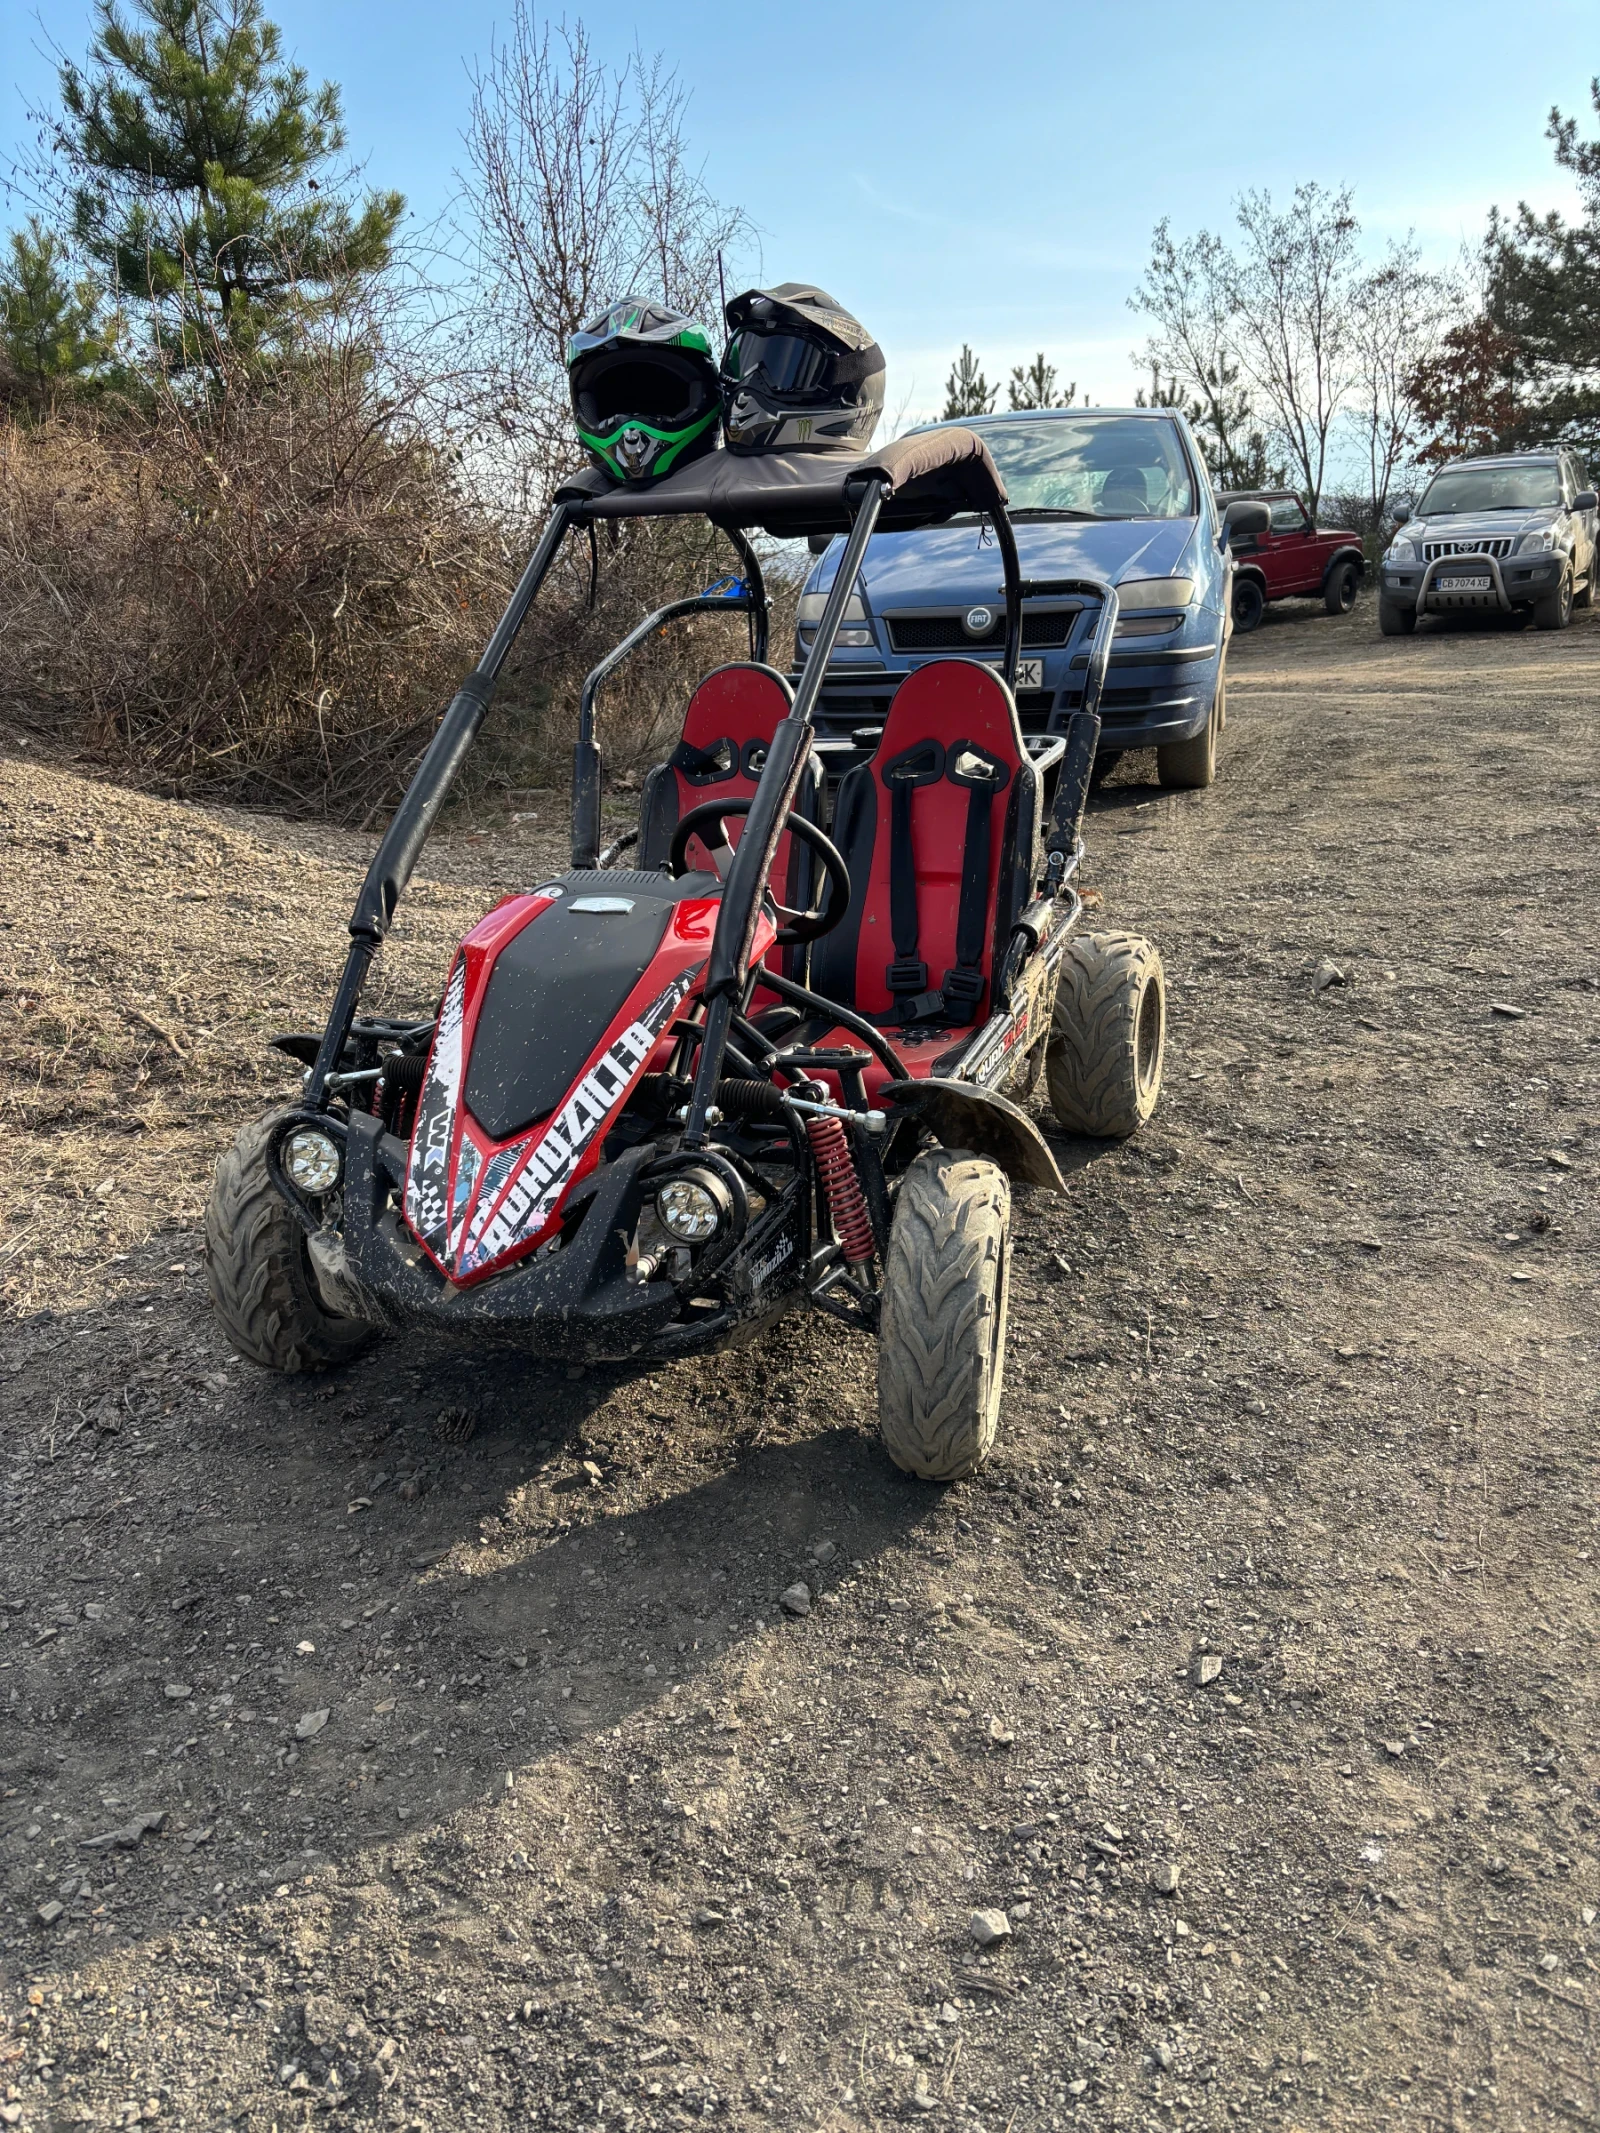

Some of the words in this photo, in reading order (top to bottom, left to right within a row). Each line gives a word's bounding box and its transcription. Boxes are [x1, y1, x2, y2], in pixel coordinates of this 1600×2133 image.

[1442, 579, 1454, 588] CB
[1455, 578, 1476, 588] 7074
[970, 614, 987, 623] FIAT
